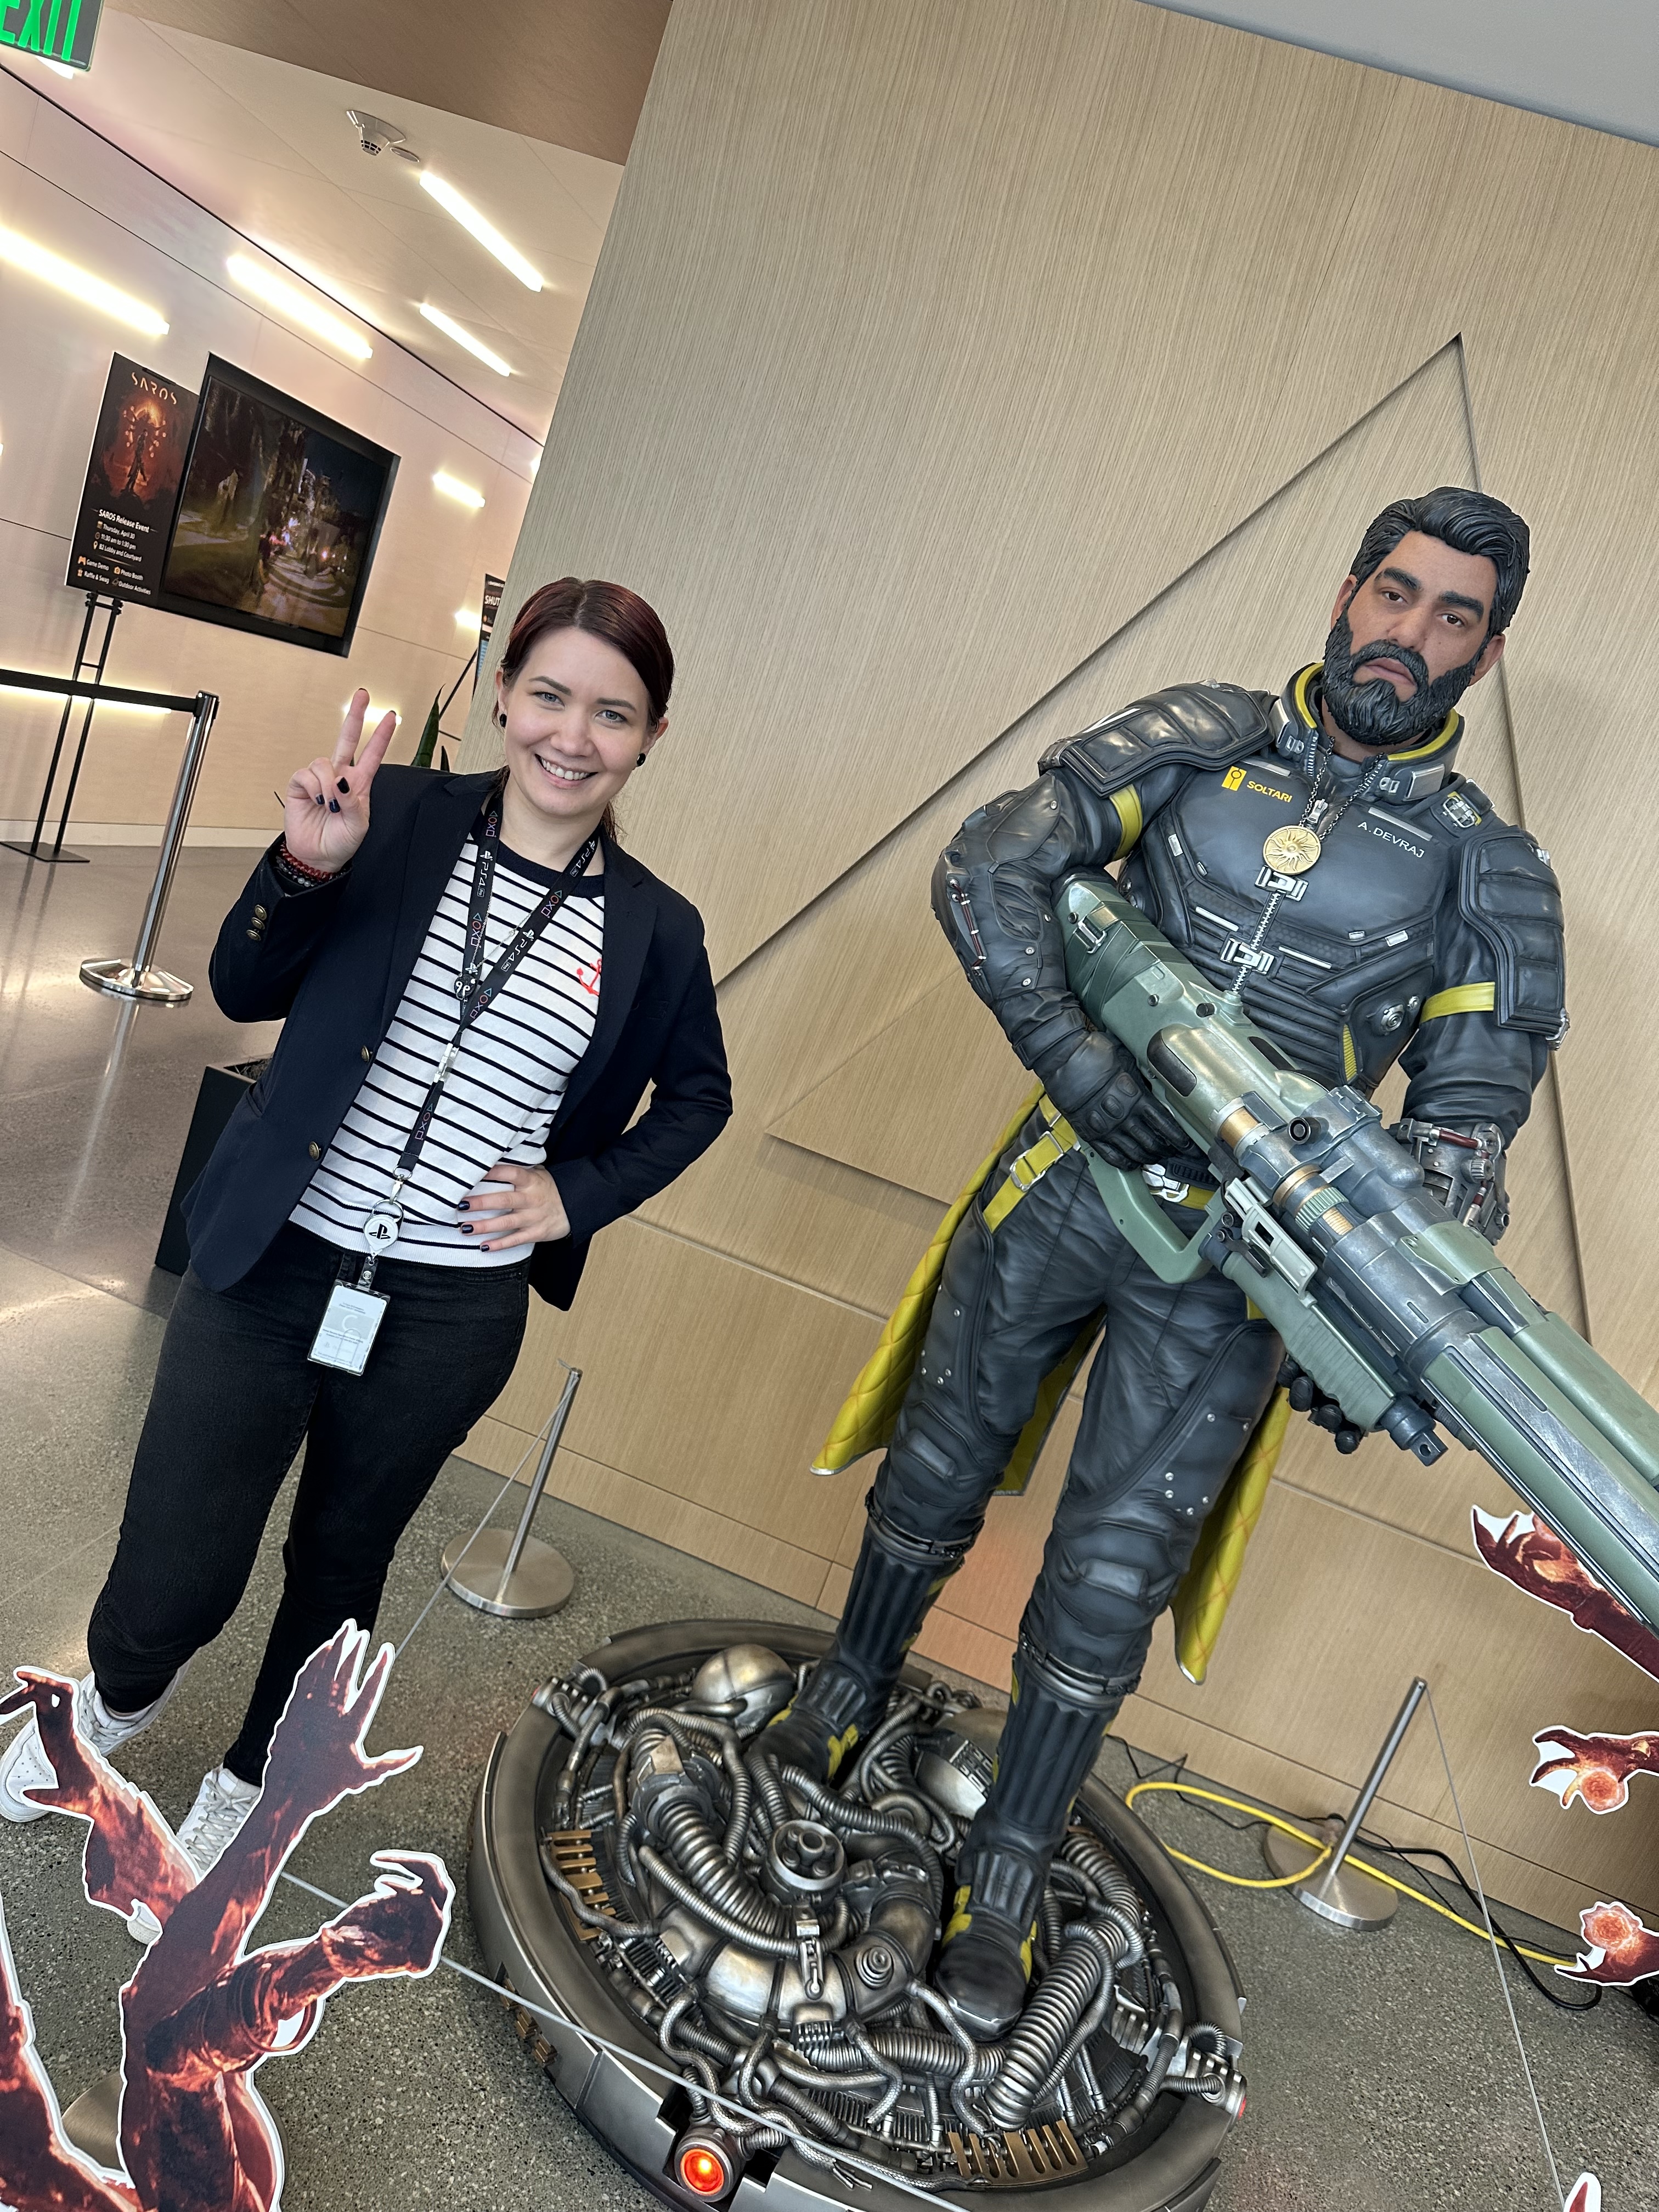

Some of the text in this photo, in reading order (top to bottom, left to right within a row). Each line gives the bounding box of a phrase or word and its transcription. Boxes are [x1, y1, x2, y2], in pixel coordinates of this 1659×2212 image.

[131, 372, 177, 405] SAROS
[99, 509, 150, 533] SAROS Release Event
[104, 545, 115, 555] Lobby
[123, 551, 142, 562] Courtyard
[1246, 781, 1293, 803] SOLTARI
[575, 848, 591, 868] PS4
[479, 861, 489, 886] PS4
[508, 938, 528, 962] PS4
